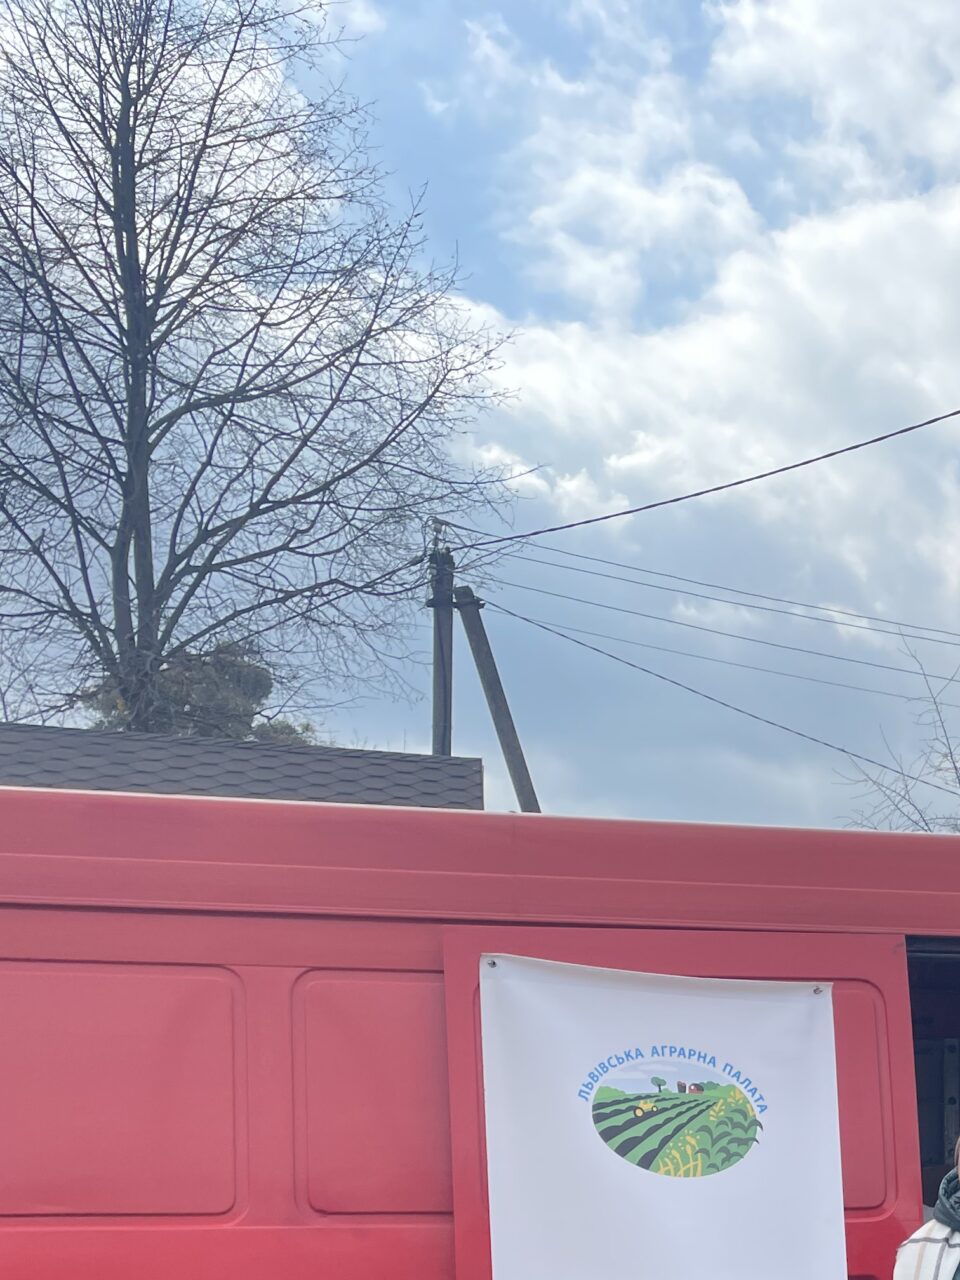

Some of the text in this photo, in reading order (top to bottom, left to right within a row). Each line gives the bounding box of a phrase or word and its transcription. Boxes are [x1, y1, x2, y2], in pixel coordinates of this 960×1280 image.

[577, 1045, 768, 1114] ЛЬВІВСЬКА АГРАРНА ПАЛАТА
